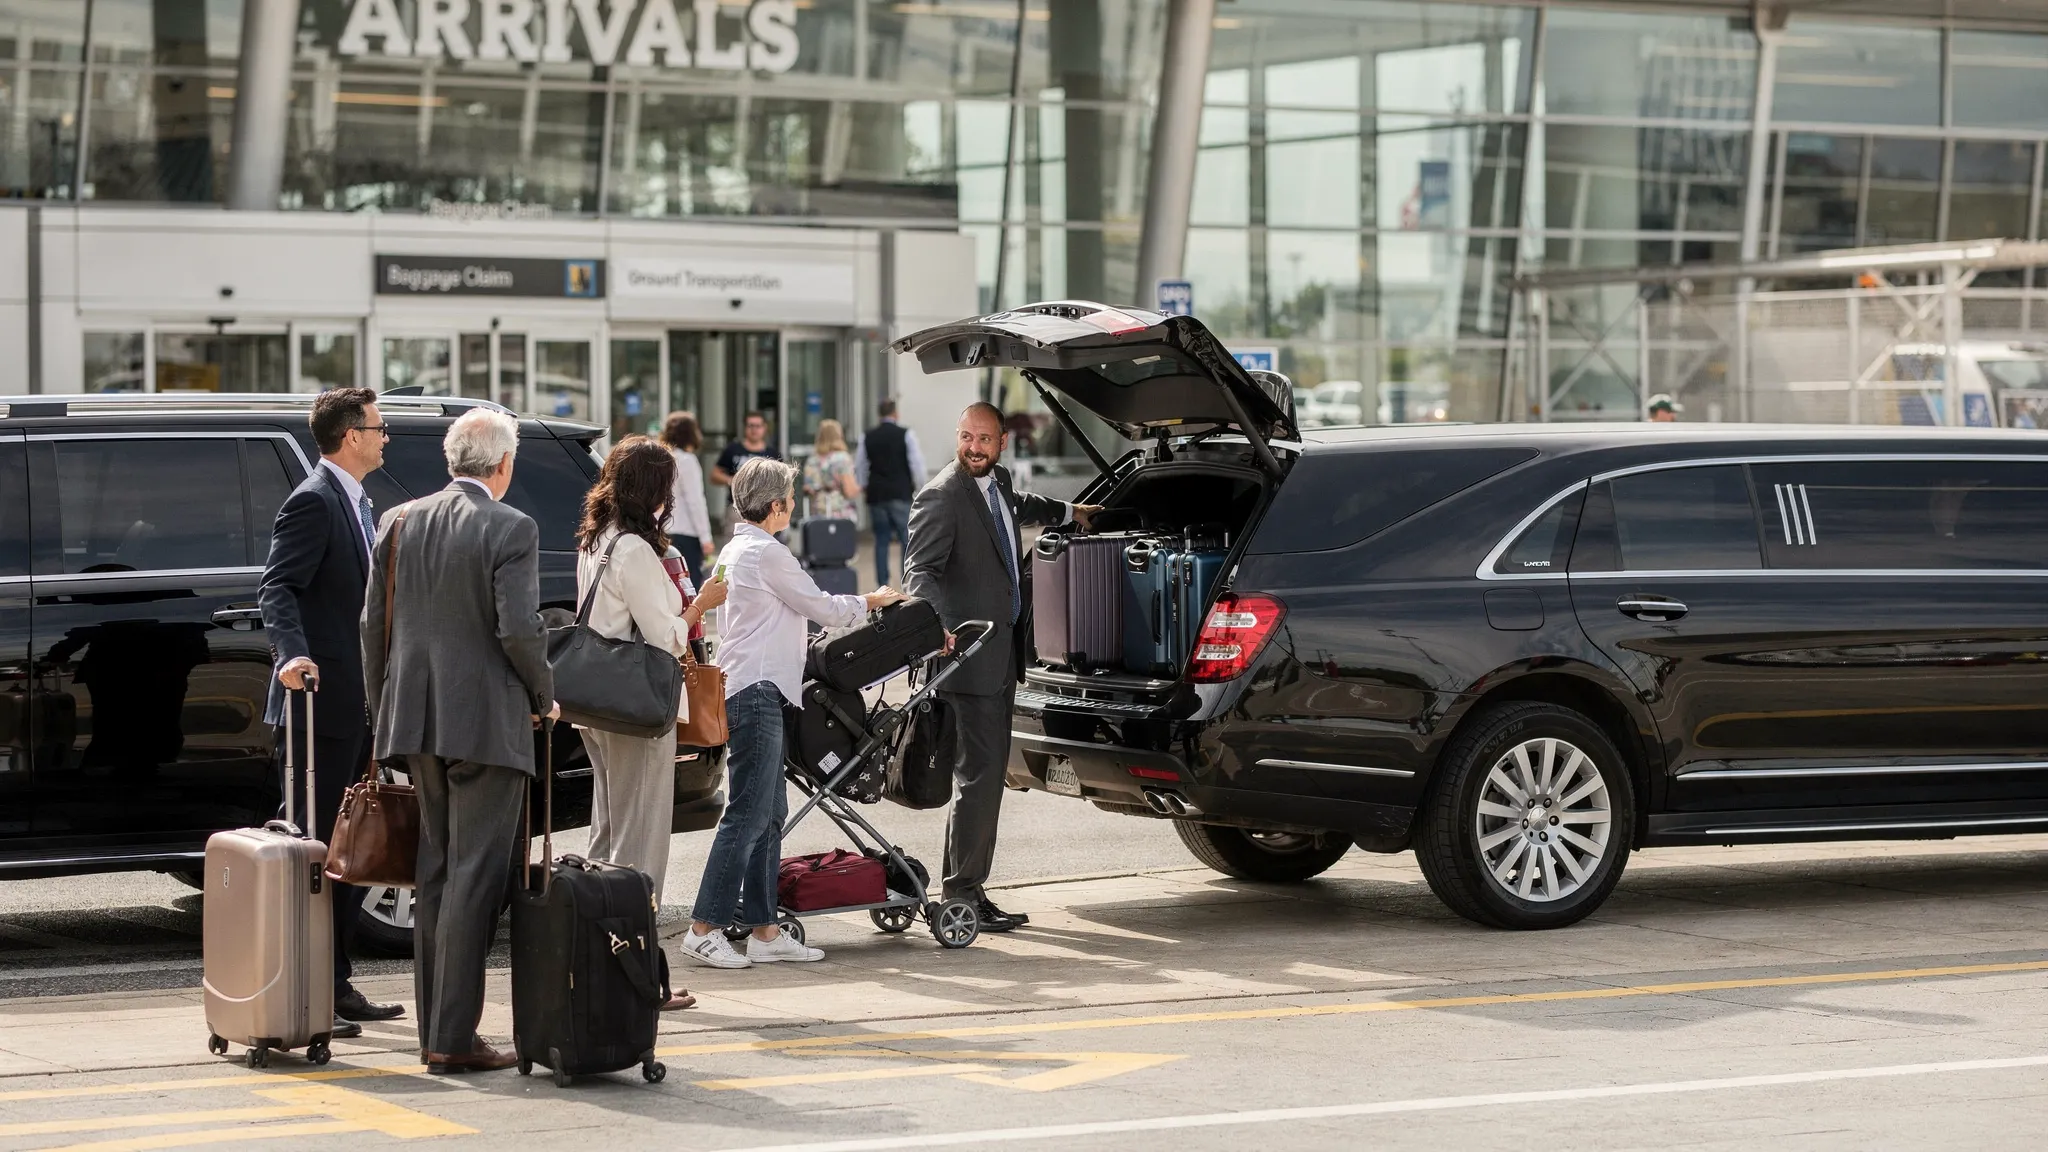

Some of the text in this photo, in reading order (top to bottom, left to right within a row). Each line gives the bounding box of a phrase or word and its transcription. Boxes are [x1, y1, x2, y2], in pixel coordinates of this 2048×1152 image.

[338, 0, 801, 73] ARRIVALS
[463, 265, 514, 288] Claim
[628, 269, 681, 287] Ground
